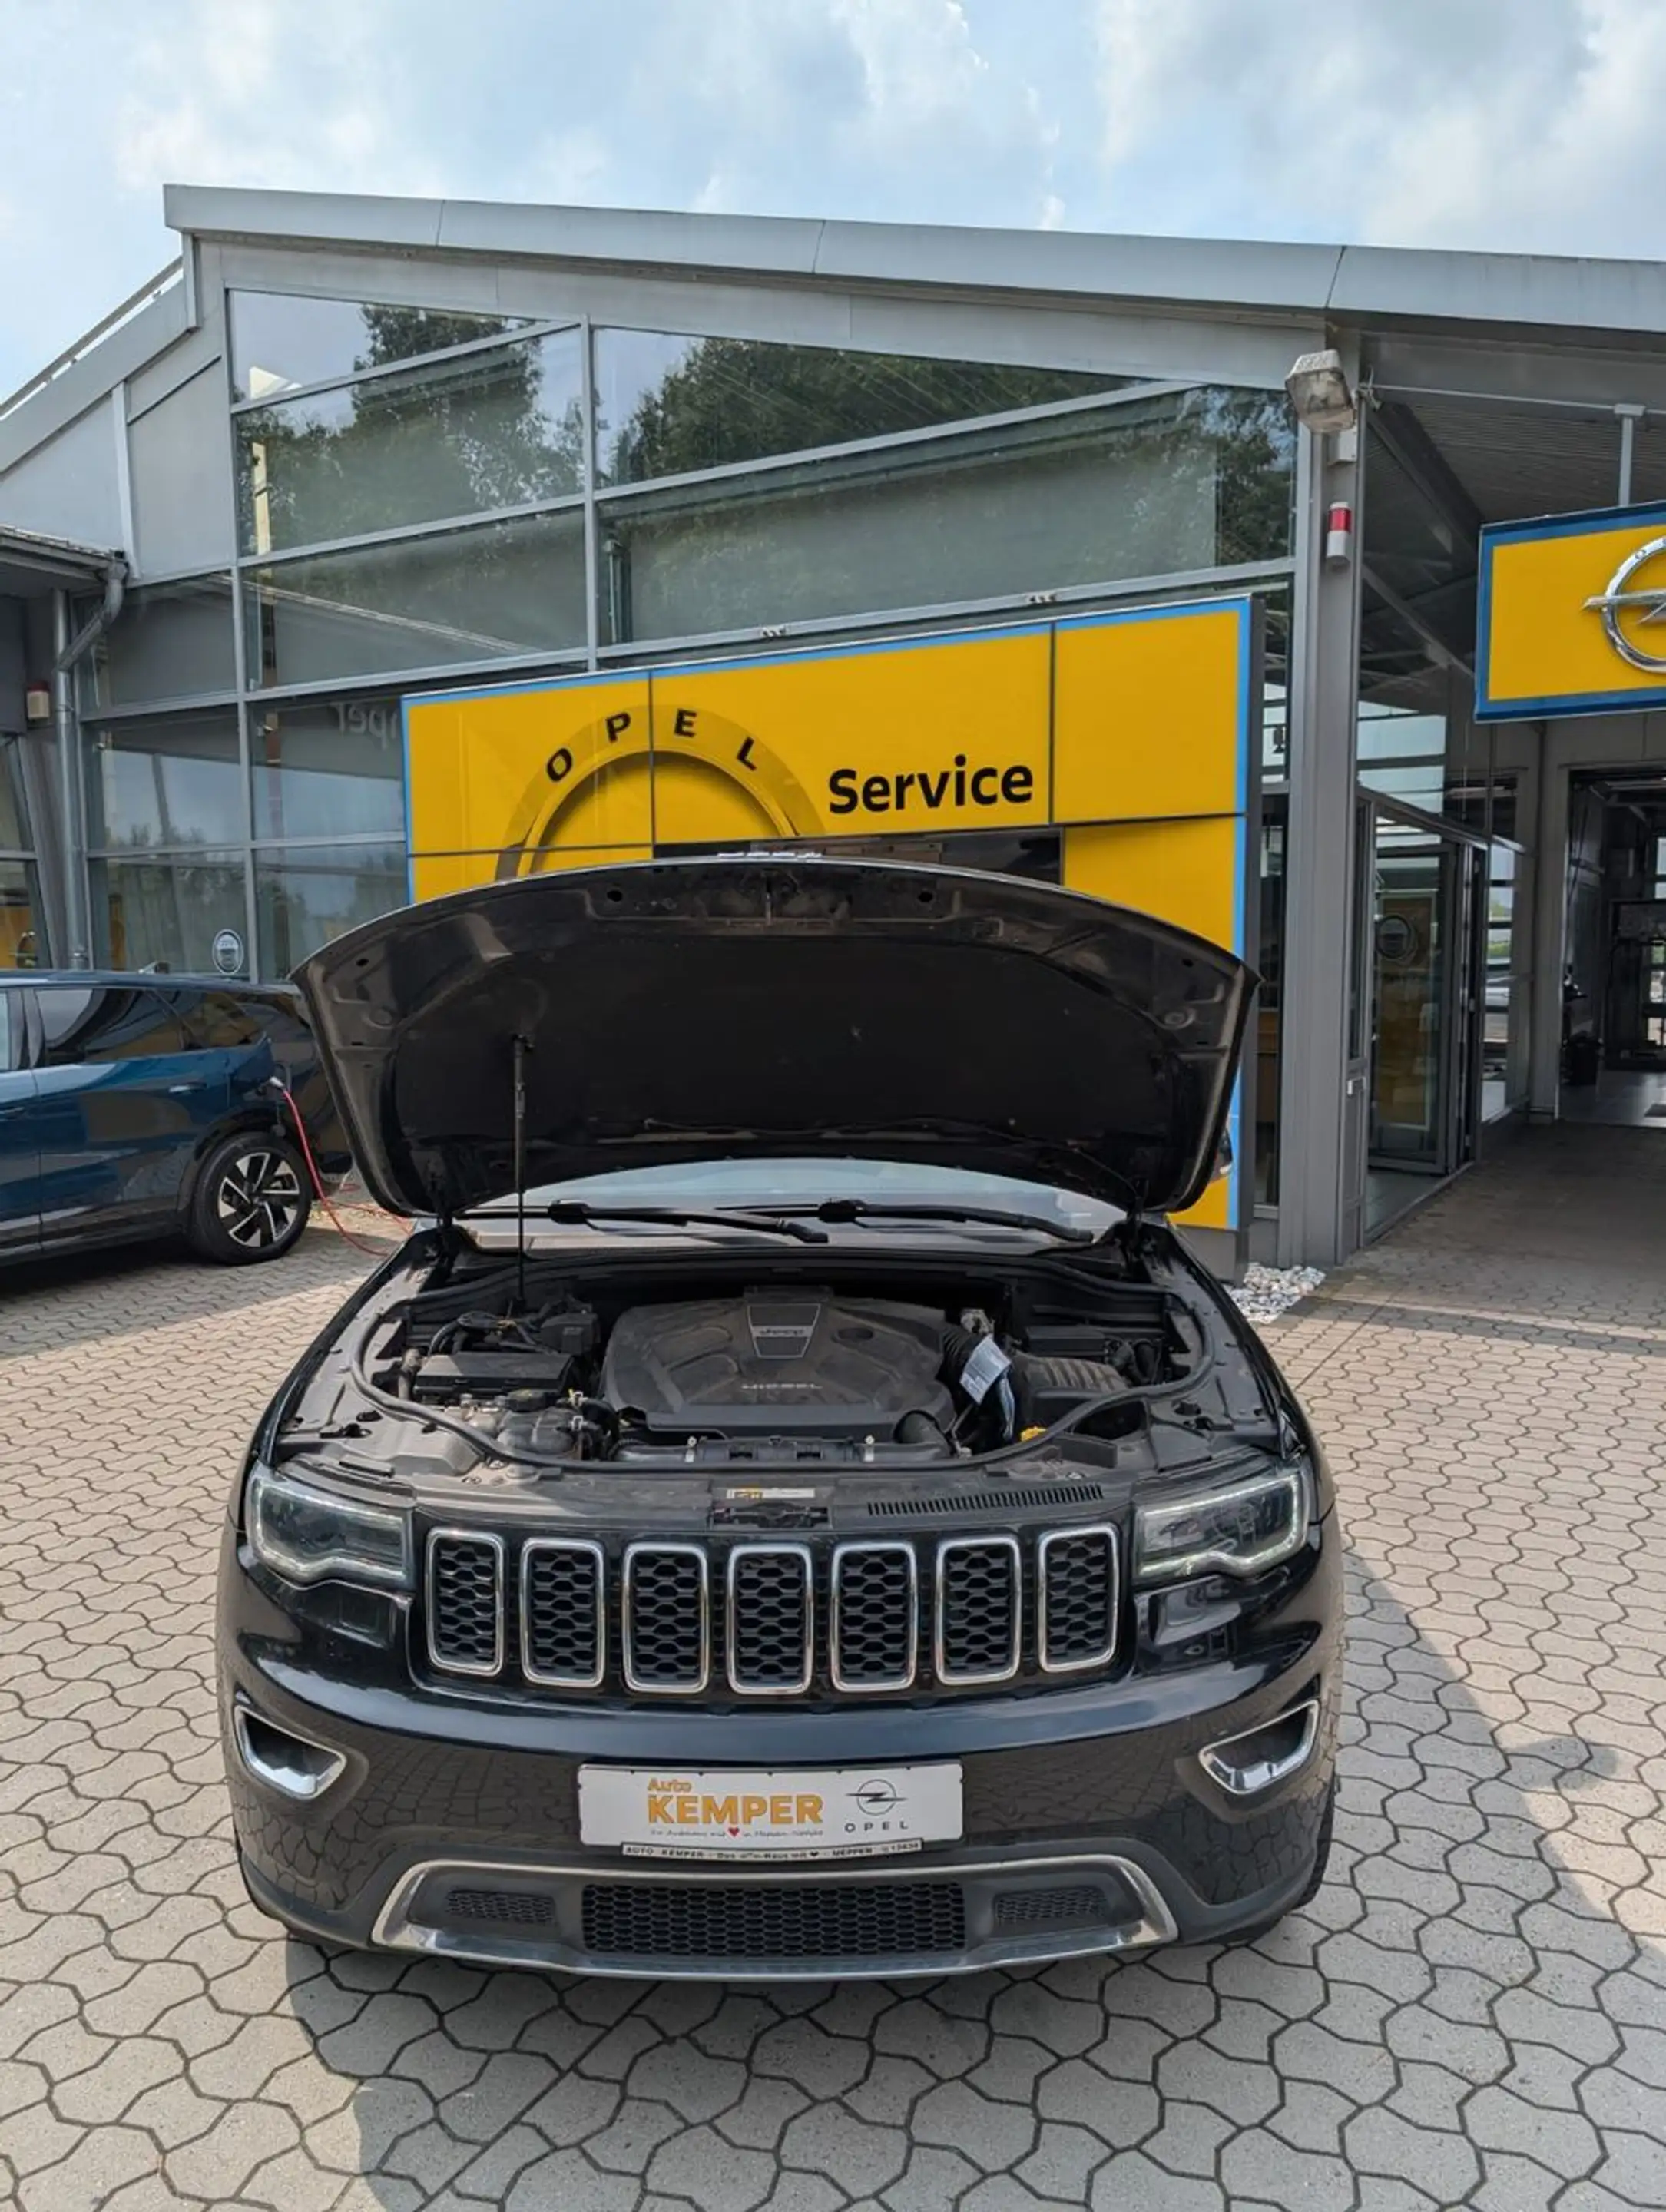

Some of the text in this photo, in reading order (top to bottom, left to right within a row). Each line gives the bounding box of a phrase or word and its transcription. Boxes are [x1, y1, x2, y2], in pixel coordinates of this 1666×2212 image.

[545, 707, 757, 783] OPEL
[828, 753, 1033, 814] Service
[648, 1777, 692, 1792] Auto
[648, 1794, 823, 1824] KEMPER
[844, 1820, 908, 1833] OPEL
